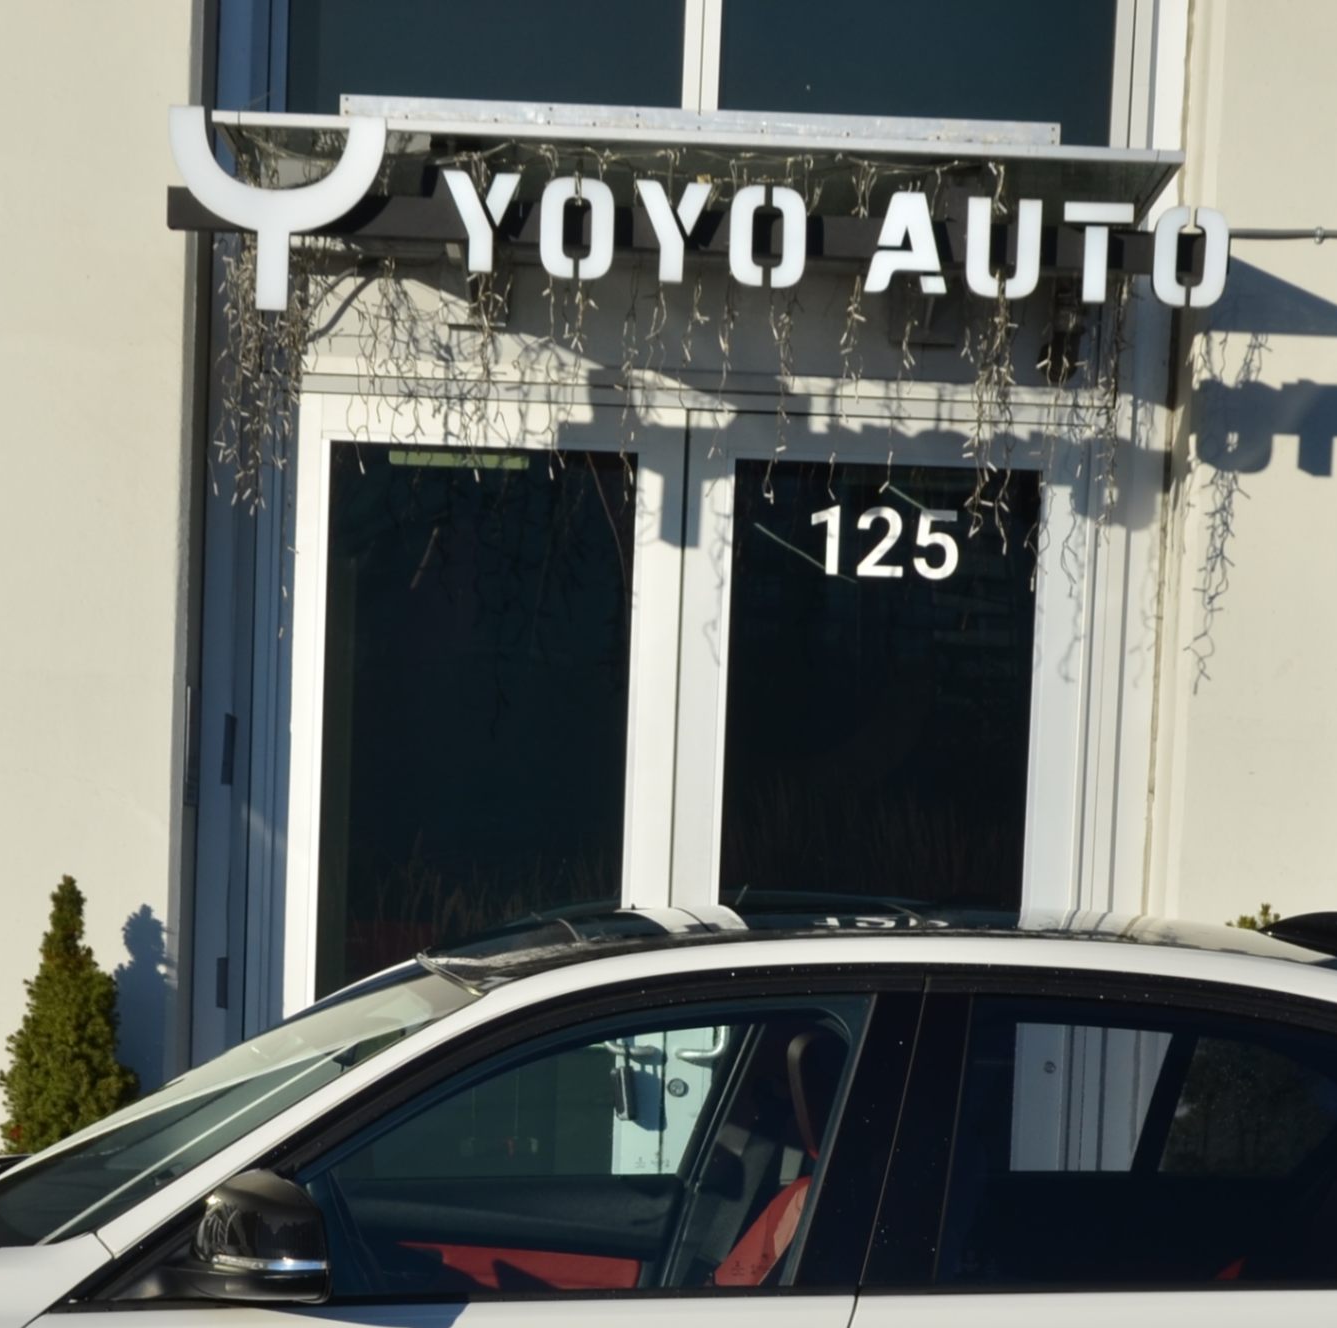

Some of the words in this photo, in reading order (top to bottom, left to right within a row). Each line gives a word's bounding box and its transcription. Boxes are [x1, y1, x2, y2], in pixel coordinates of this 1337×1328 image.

[443, 169, 808, 288] YOYO
[864, 191, 1230, 309] AUTO
[810, 504, 960, 581] 125
